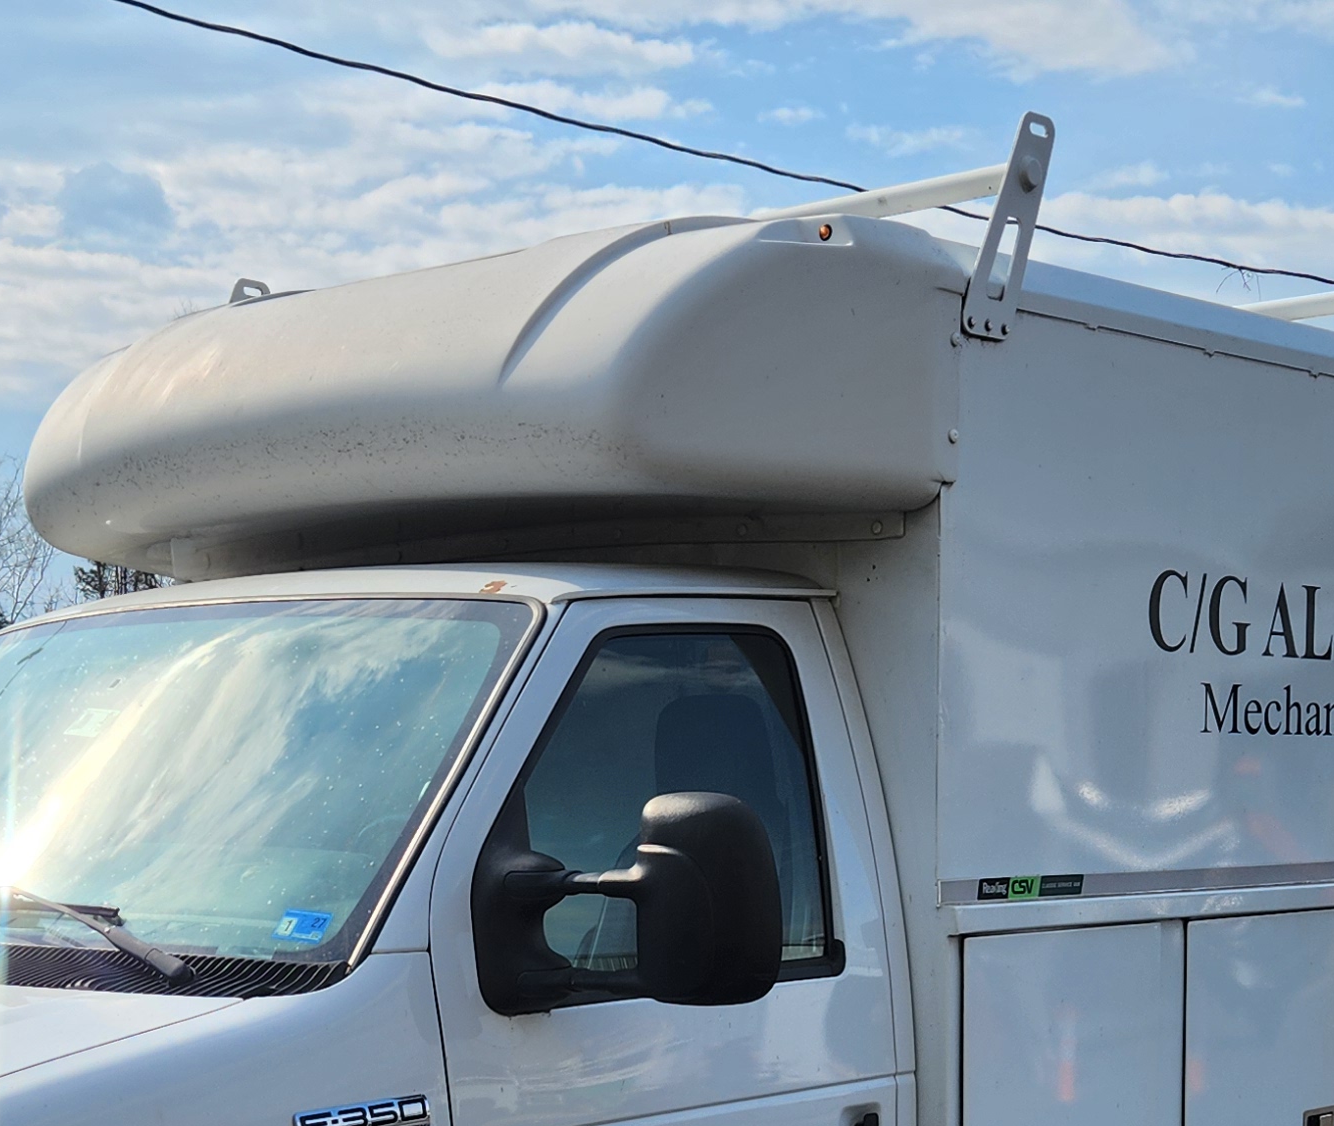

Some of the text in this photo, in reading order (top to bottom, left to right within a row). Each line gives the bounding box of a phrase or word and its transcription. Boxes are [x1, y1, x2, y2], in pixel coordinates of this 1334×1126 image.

[1148, 569, 1252, 657] C/G
[1011, 878, 1035, 895] CSV
[310, 917, 328, 929] 27
